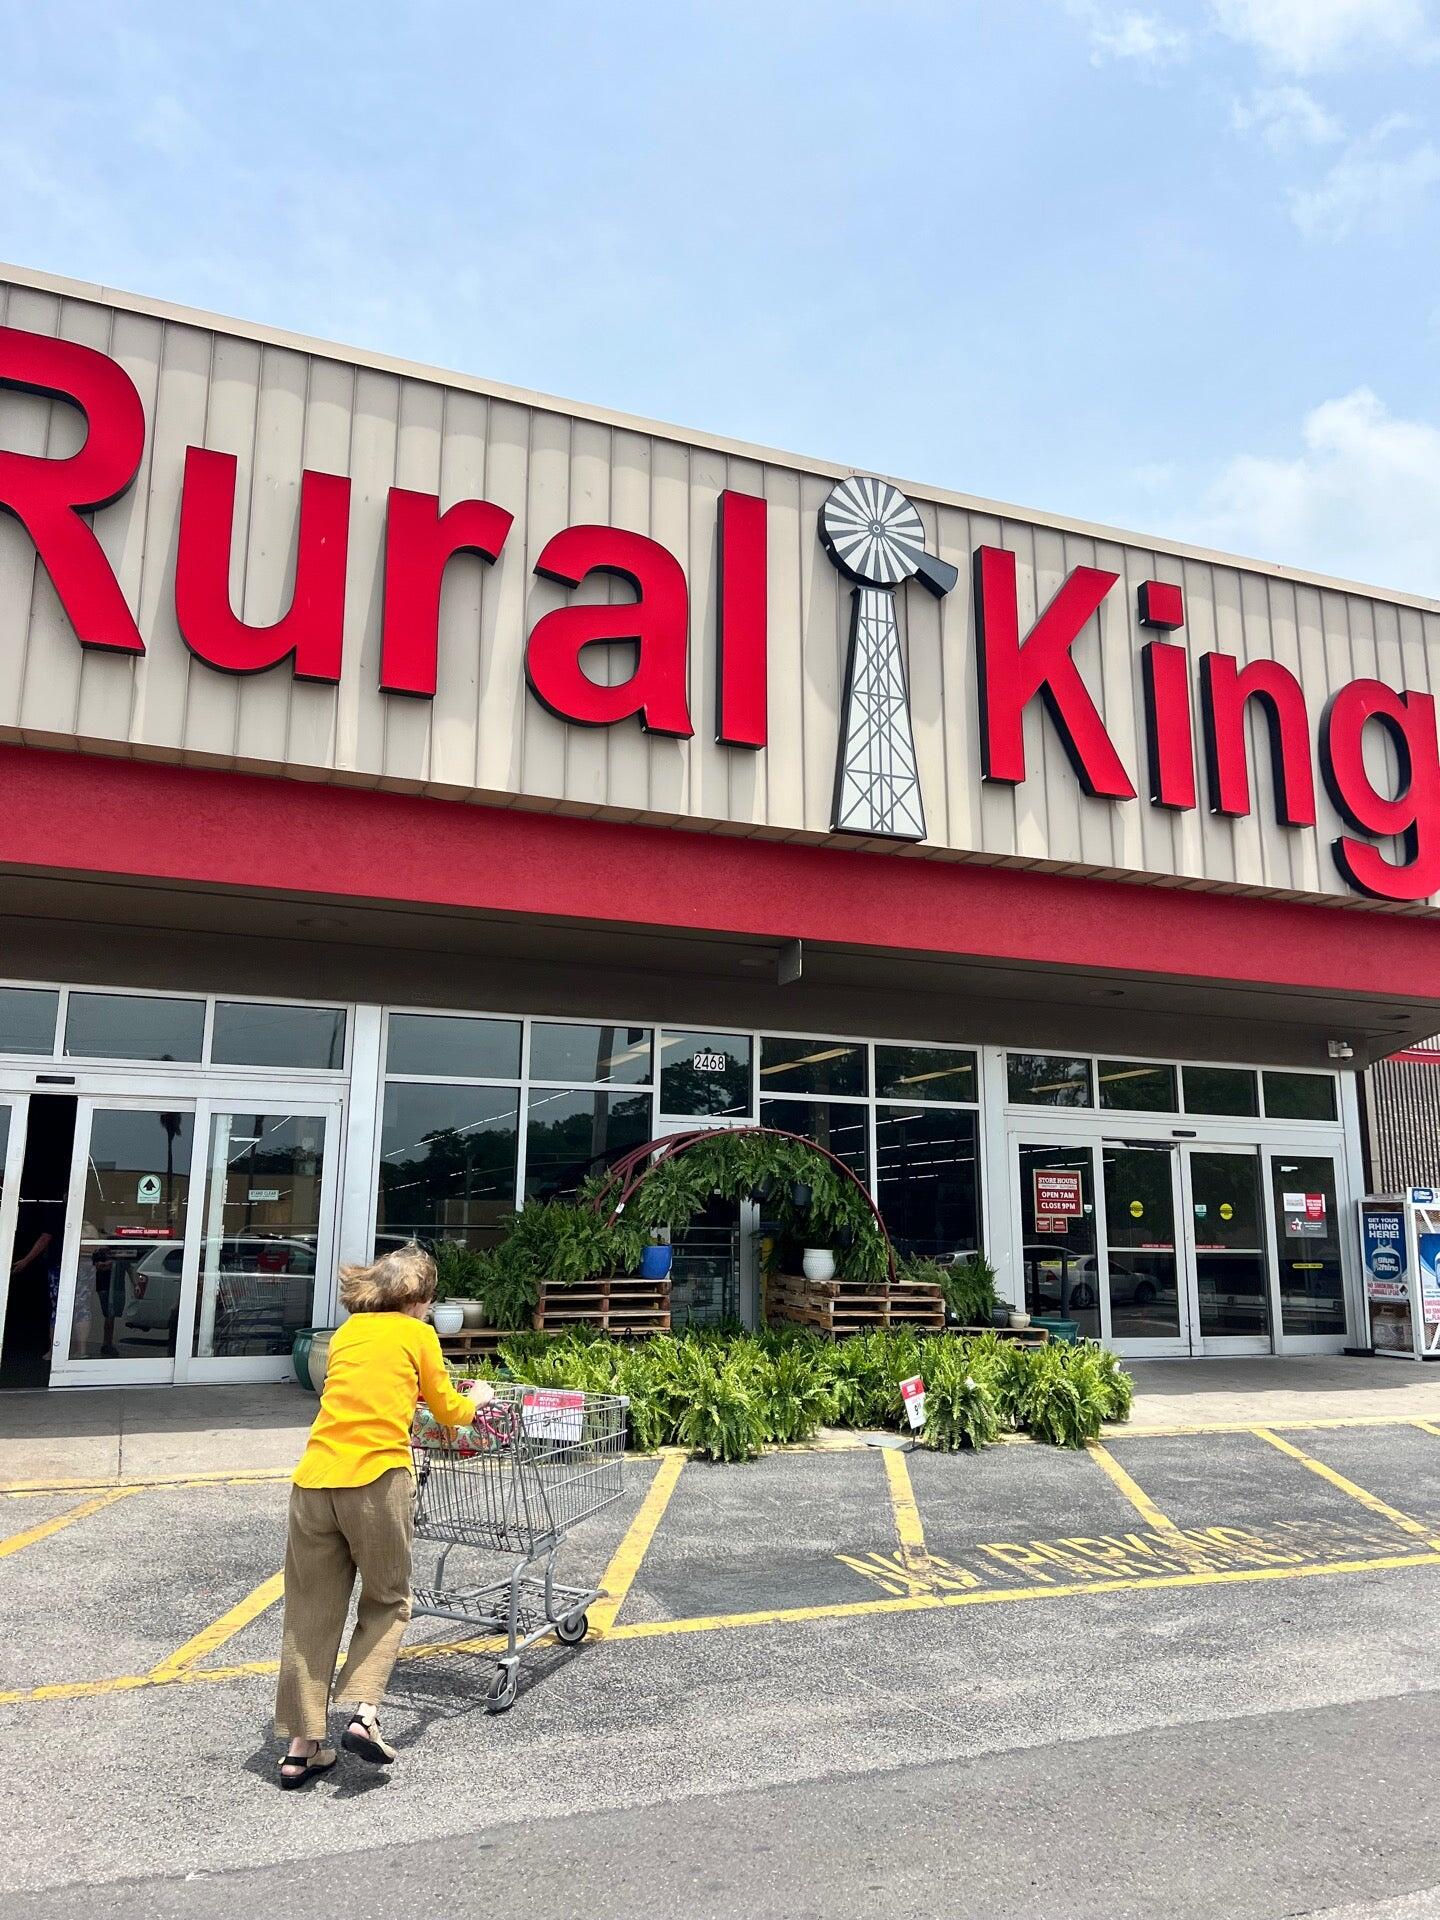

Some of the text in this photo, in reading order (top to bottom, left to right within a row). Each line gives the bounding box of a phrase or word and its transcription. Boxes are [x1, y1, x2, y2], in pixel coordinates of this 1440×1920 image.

[0, 325, 1440, 900] Rural King
[694, 1054, 724, 1070] 2468
[1038, 1176, 1057, 1184] STORE
[1061, 1202, 1076, 1210] 9PM
[1368, 1230, 1400, 1239] HERE!
[1377, 1256, 1396, 1265] Blue
[834, 1550, 979, 1596] NO
[975, 1522, 1304, 1583] PARKING
